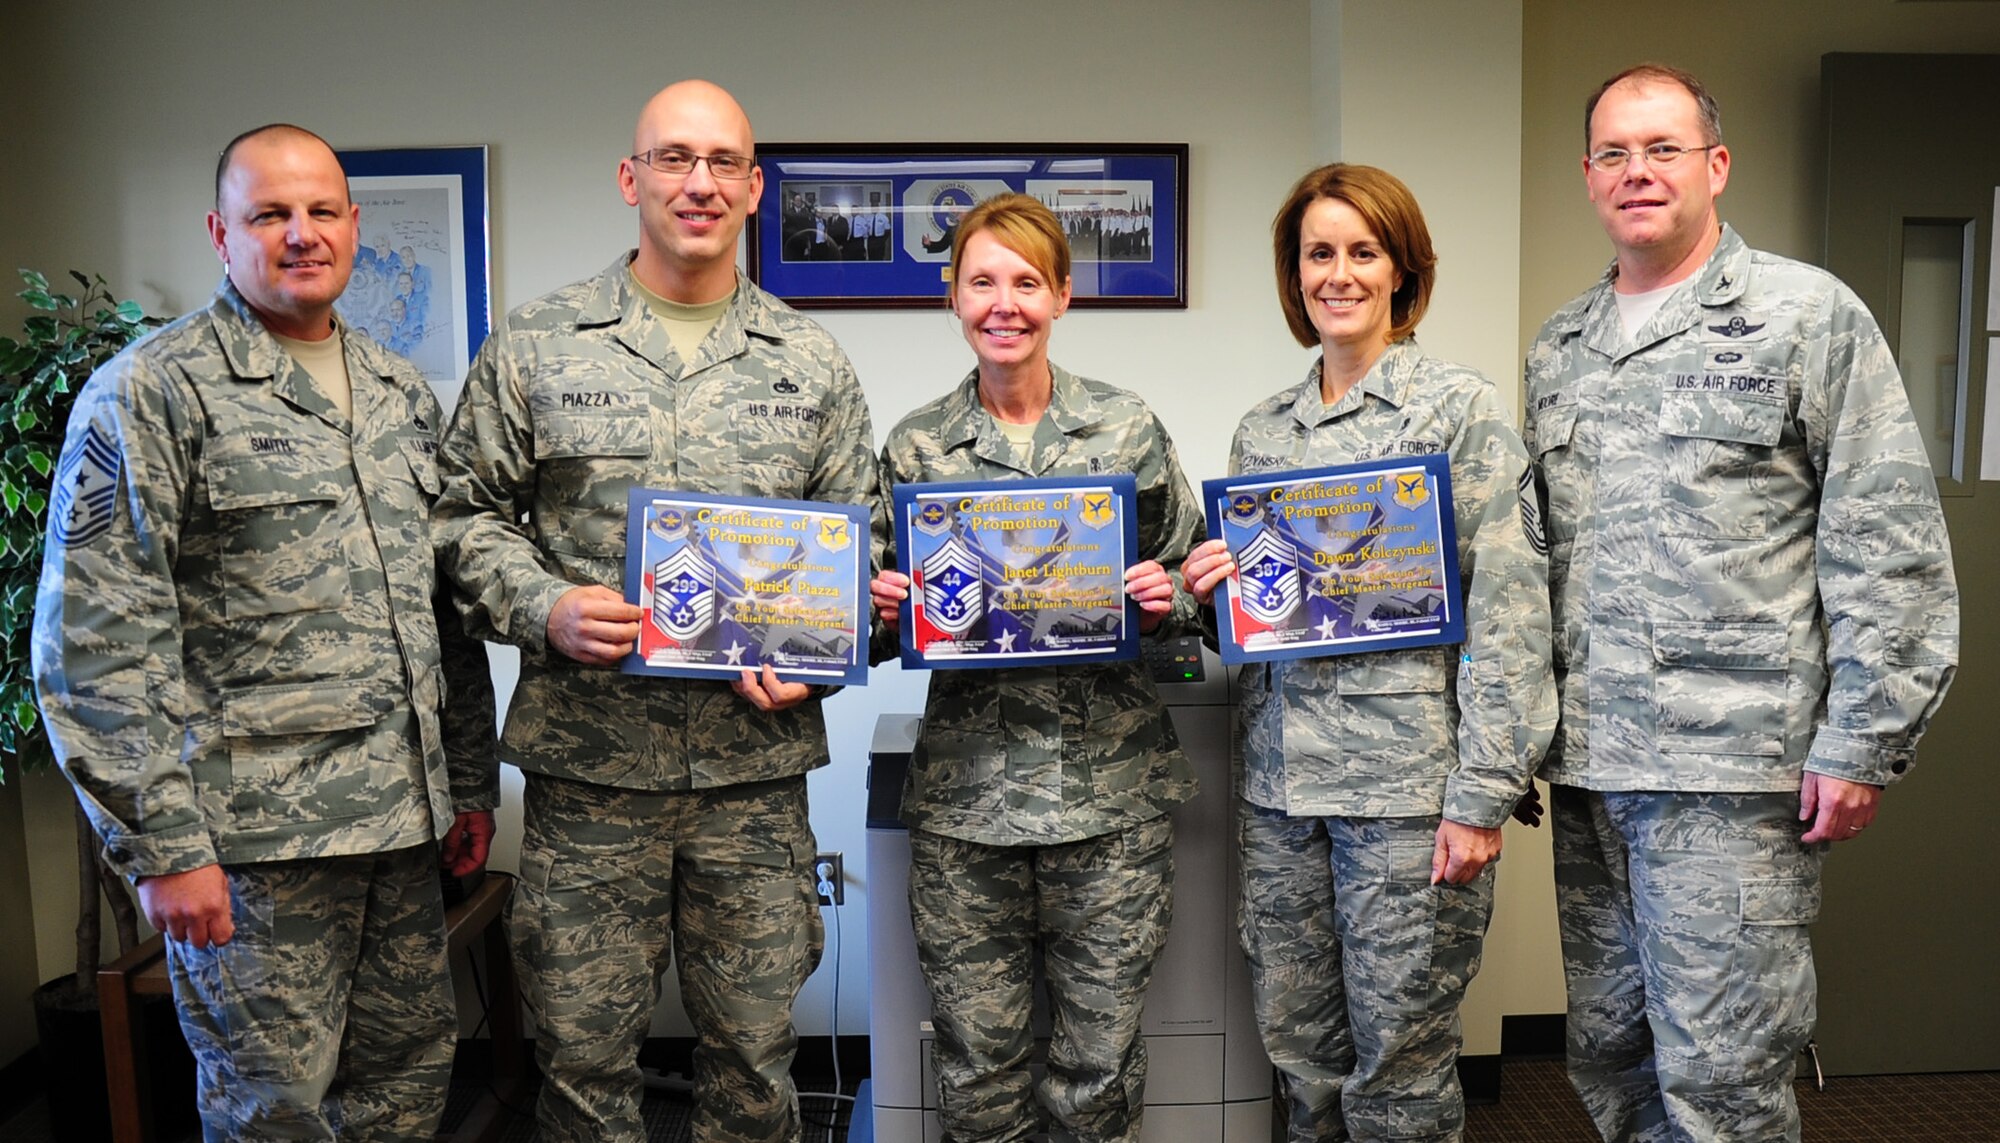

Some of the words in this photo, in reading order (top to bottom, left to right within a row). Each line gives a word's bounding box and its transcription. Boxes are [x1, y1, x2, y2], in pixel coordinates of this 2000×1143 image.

[1703, 375, 1725, 390] AIR
[1729, 376, 1775, 395] FORCE
[562, 393, 611, 408] PIAZZA
[774, 406, 793, 419] AIR
[250, 437, 292, 453] SMITH
[1400, 440, 1440, 455] FORCE
[1270, 481, 1359, 503] Certificate
[1366, 476, 1385, 493] of
[959, 497, 1046, 513] Certificate
[1053, 495, 1071, 510] of
[1284, 502, 1373, 520] Promotion
[697, 508, 785, 530] Certificate
[791, 516, 809, 531] of
[972, 517, 1058, 531] Promotion
[709, 528, 796, 547] Promotion
[1327, 524, 1416, 540] Congratulations
[1012, 543, 1100, 555] Congratulations
[1314, 552, 1355, 566] Dawn
[1360, 540, 1436, 562] Kolczynski
[749, 559, 835, 573] Congratulations
[1003, 564, 1038, 581] Janet
[1043, 561, 1111, 580] Lightburn
[1254, 562, 1282, 578] 387
[670, 579, 699, 594] 299
[744, 577, 791, 594] Patrick
[798, 581, 840, 597] Piazza
[942, 572, 961, 587] 44
[1321, 576, 1336, 585] On
[1341, 574, 1364, 584] Your
[1023, 590, 1047, 599] Your
[1321, 586, 1349, 597] Chief
[1353, 583, 1386, 594] Master
[1390, 579, 1433, 591] Sergeant
[735, 604, 751, 612] On
[757, 605, 780, 613] Your
[1003, 600, 1030, 611] Chief
[1034, 599, 1068, 610] Master
[1073, 598, 1113, 609] Sergeant
[734, 614, 762, 625] Chief
[766, 615, 799, 625] Master
[804, 618, 846, 629] Sergeant
